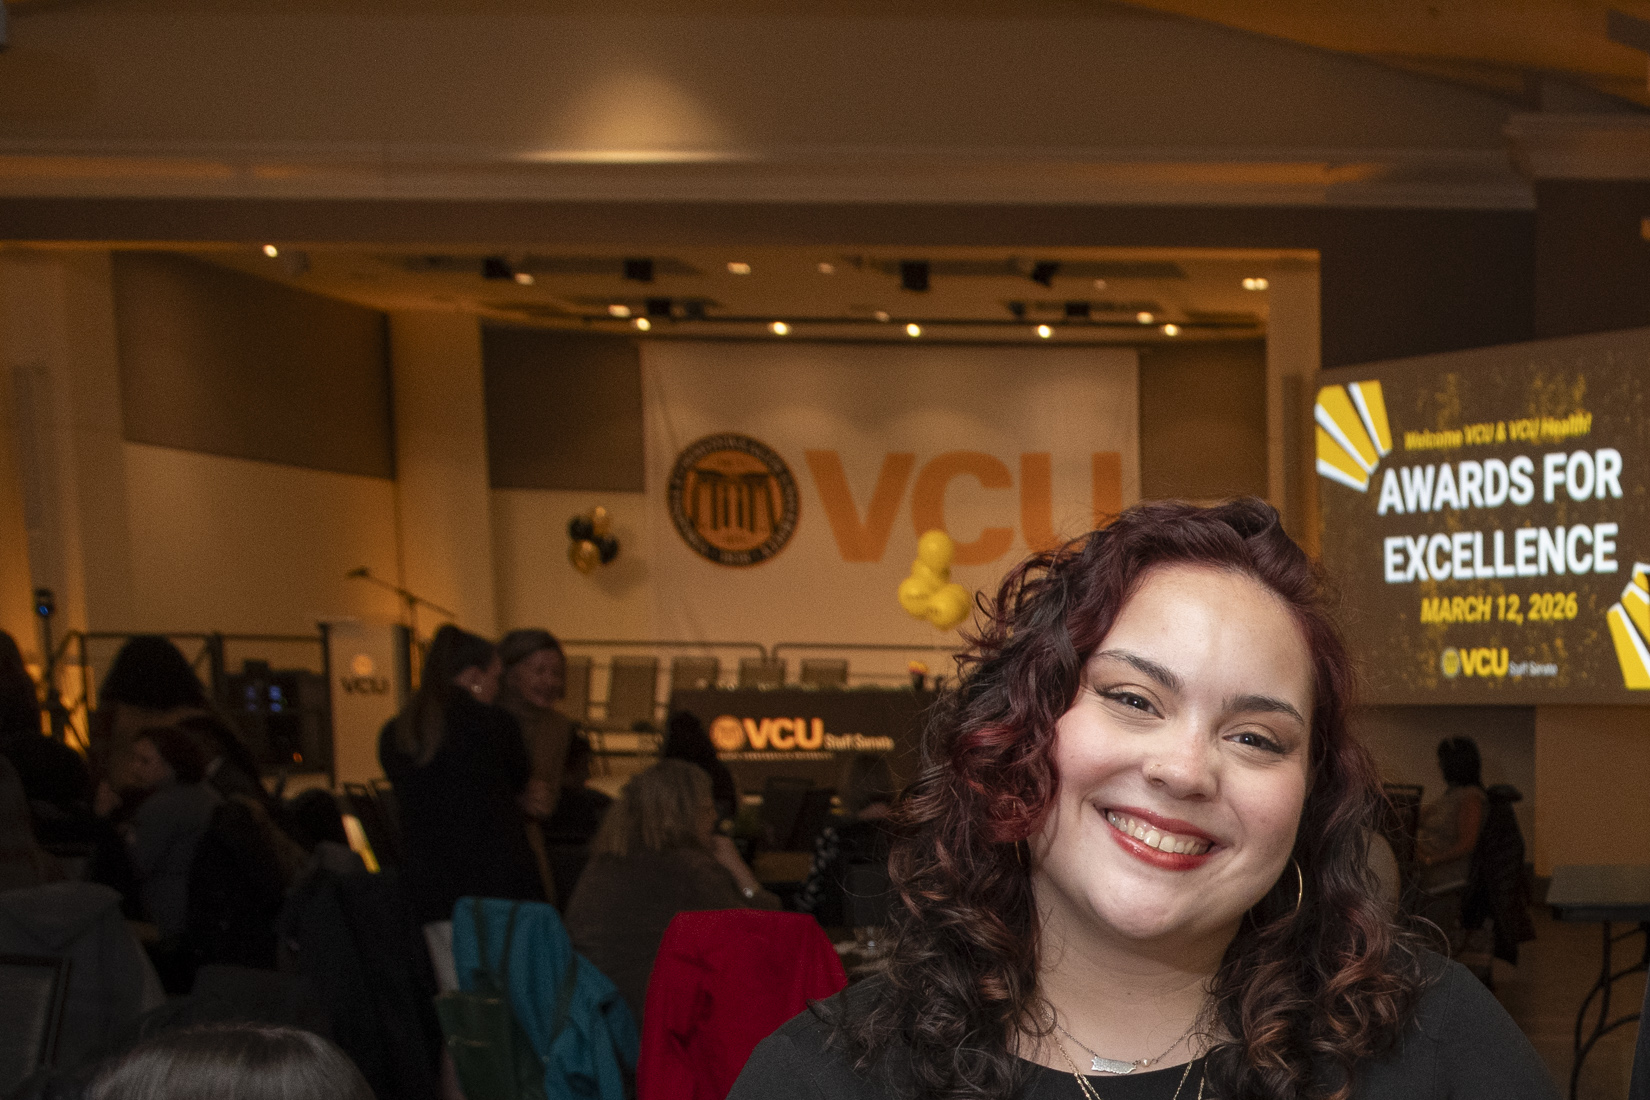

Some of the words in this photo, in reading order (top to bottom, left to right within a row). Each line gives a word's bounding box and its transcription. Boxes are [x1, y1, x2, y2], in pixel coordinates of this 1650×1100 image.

[1404, 429, 1463, 451] Welcome
[1463, 422, 1494, 446] VCU
[1495, 420, 1507, 444] &
[1508, 417, 1540, 441] VCU
[1377, 455, 1534, 516] AWARDS
[1543, 448, 1623, 504] FOR
[805, 450, 1122, 567] VCU
[1384, 522, 1619, 583] EXCELLENCE
[1420, 595, 1492, 624] MARCH
[1497, 593, 1524, 626] 12,
[1527, 591, 1578, 621] 2026
[1460, 647, 1509, 678] VCU
[340, 677, 390, 695] VCU
[742, 717, 824, 750] VCU
